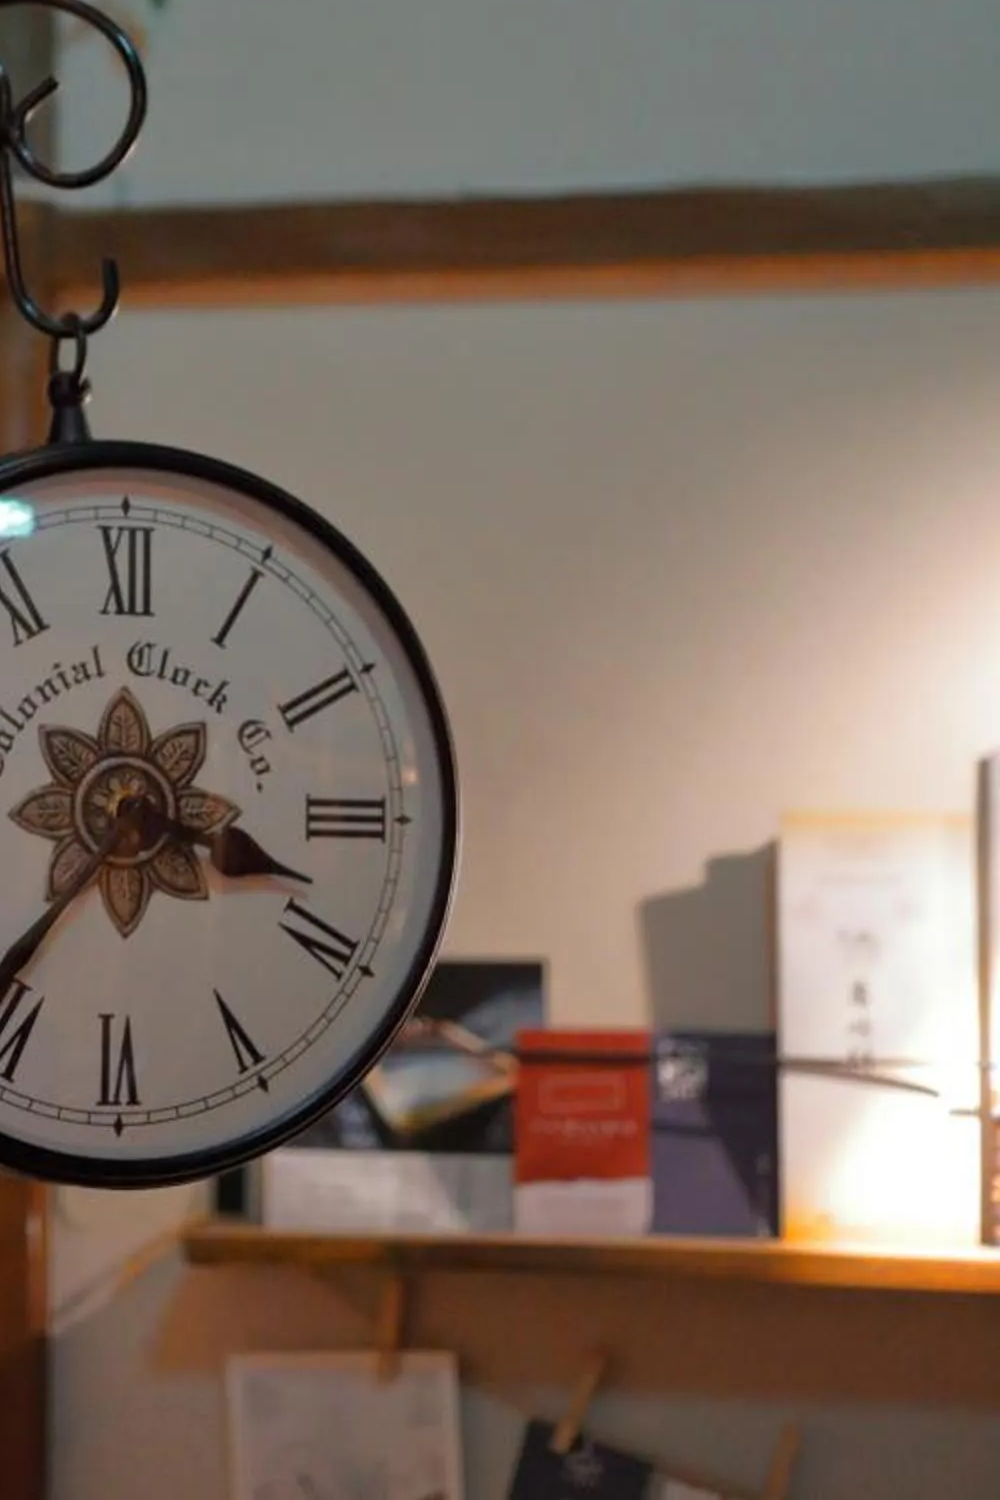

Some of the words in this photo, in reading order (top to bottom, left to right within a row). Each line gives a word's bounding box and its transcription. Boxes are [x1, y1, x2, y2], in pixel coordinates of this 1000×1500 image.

[97, 526, 155, 617] XII
[210, 567, 265, 649] I
[126, 641, 231, 714] Clock
[237, 719, 273, 793] Co.
[277, 663, 360, 733] II
[306, 793, 386, 843] III
[278, 897, 360, 982] IV
[96, 1013, 142, 1106] VI
[213, 988, 266, 1075] V
